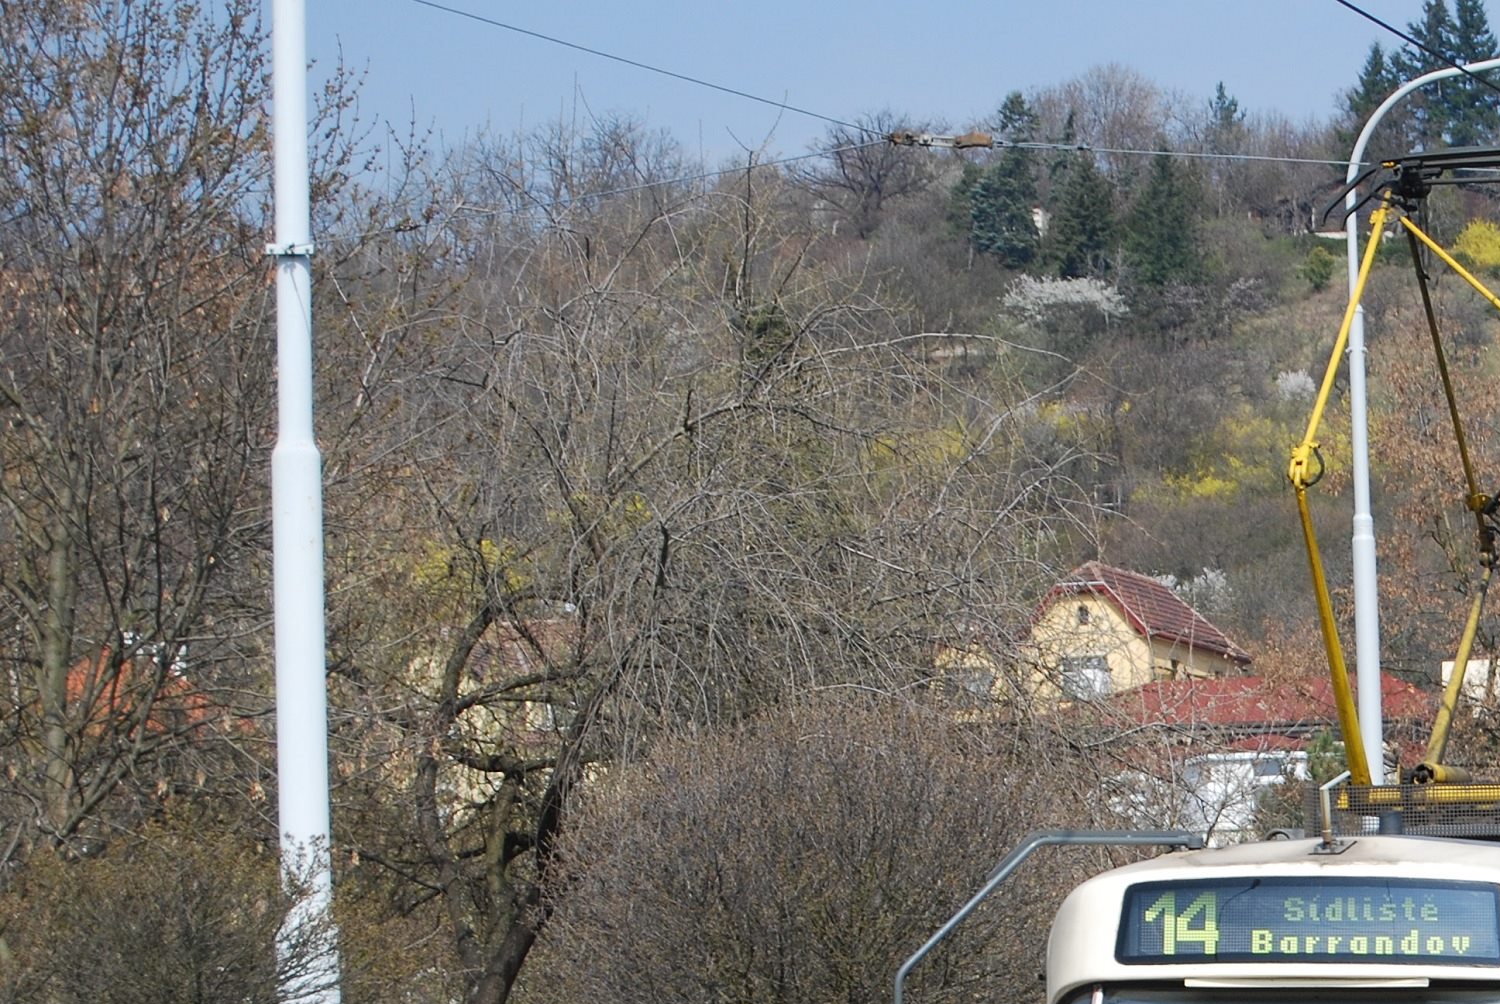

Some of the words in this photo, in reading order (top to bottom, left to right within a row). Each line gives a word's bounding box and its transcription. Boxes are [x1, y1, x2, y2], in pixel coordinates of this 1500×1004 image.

[1283, 893, 1439, 922] Sídliště
[1144, 891, 1220, 956] 14
[1251, 929, 1471, 955] Barrandov
